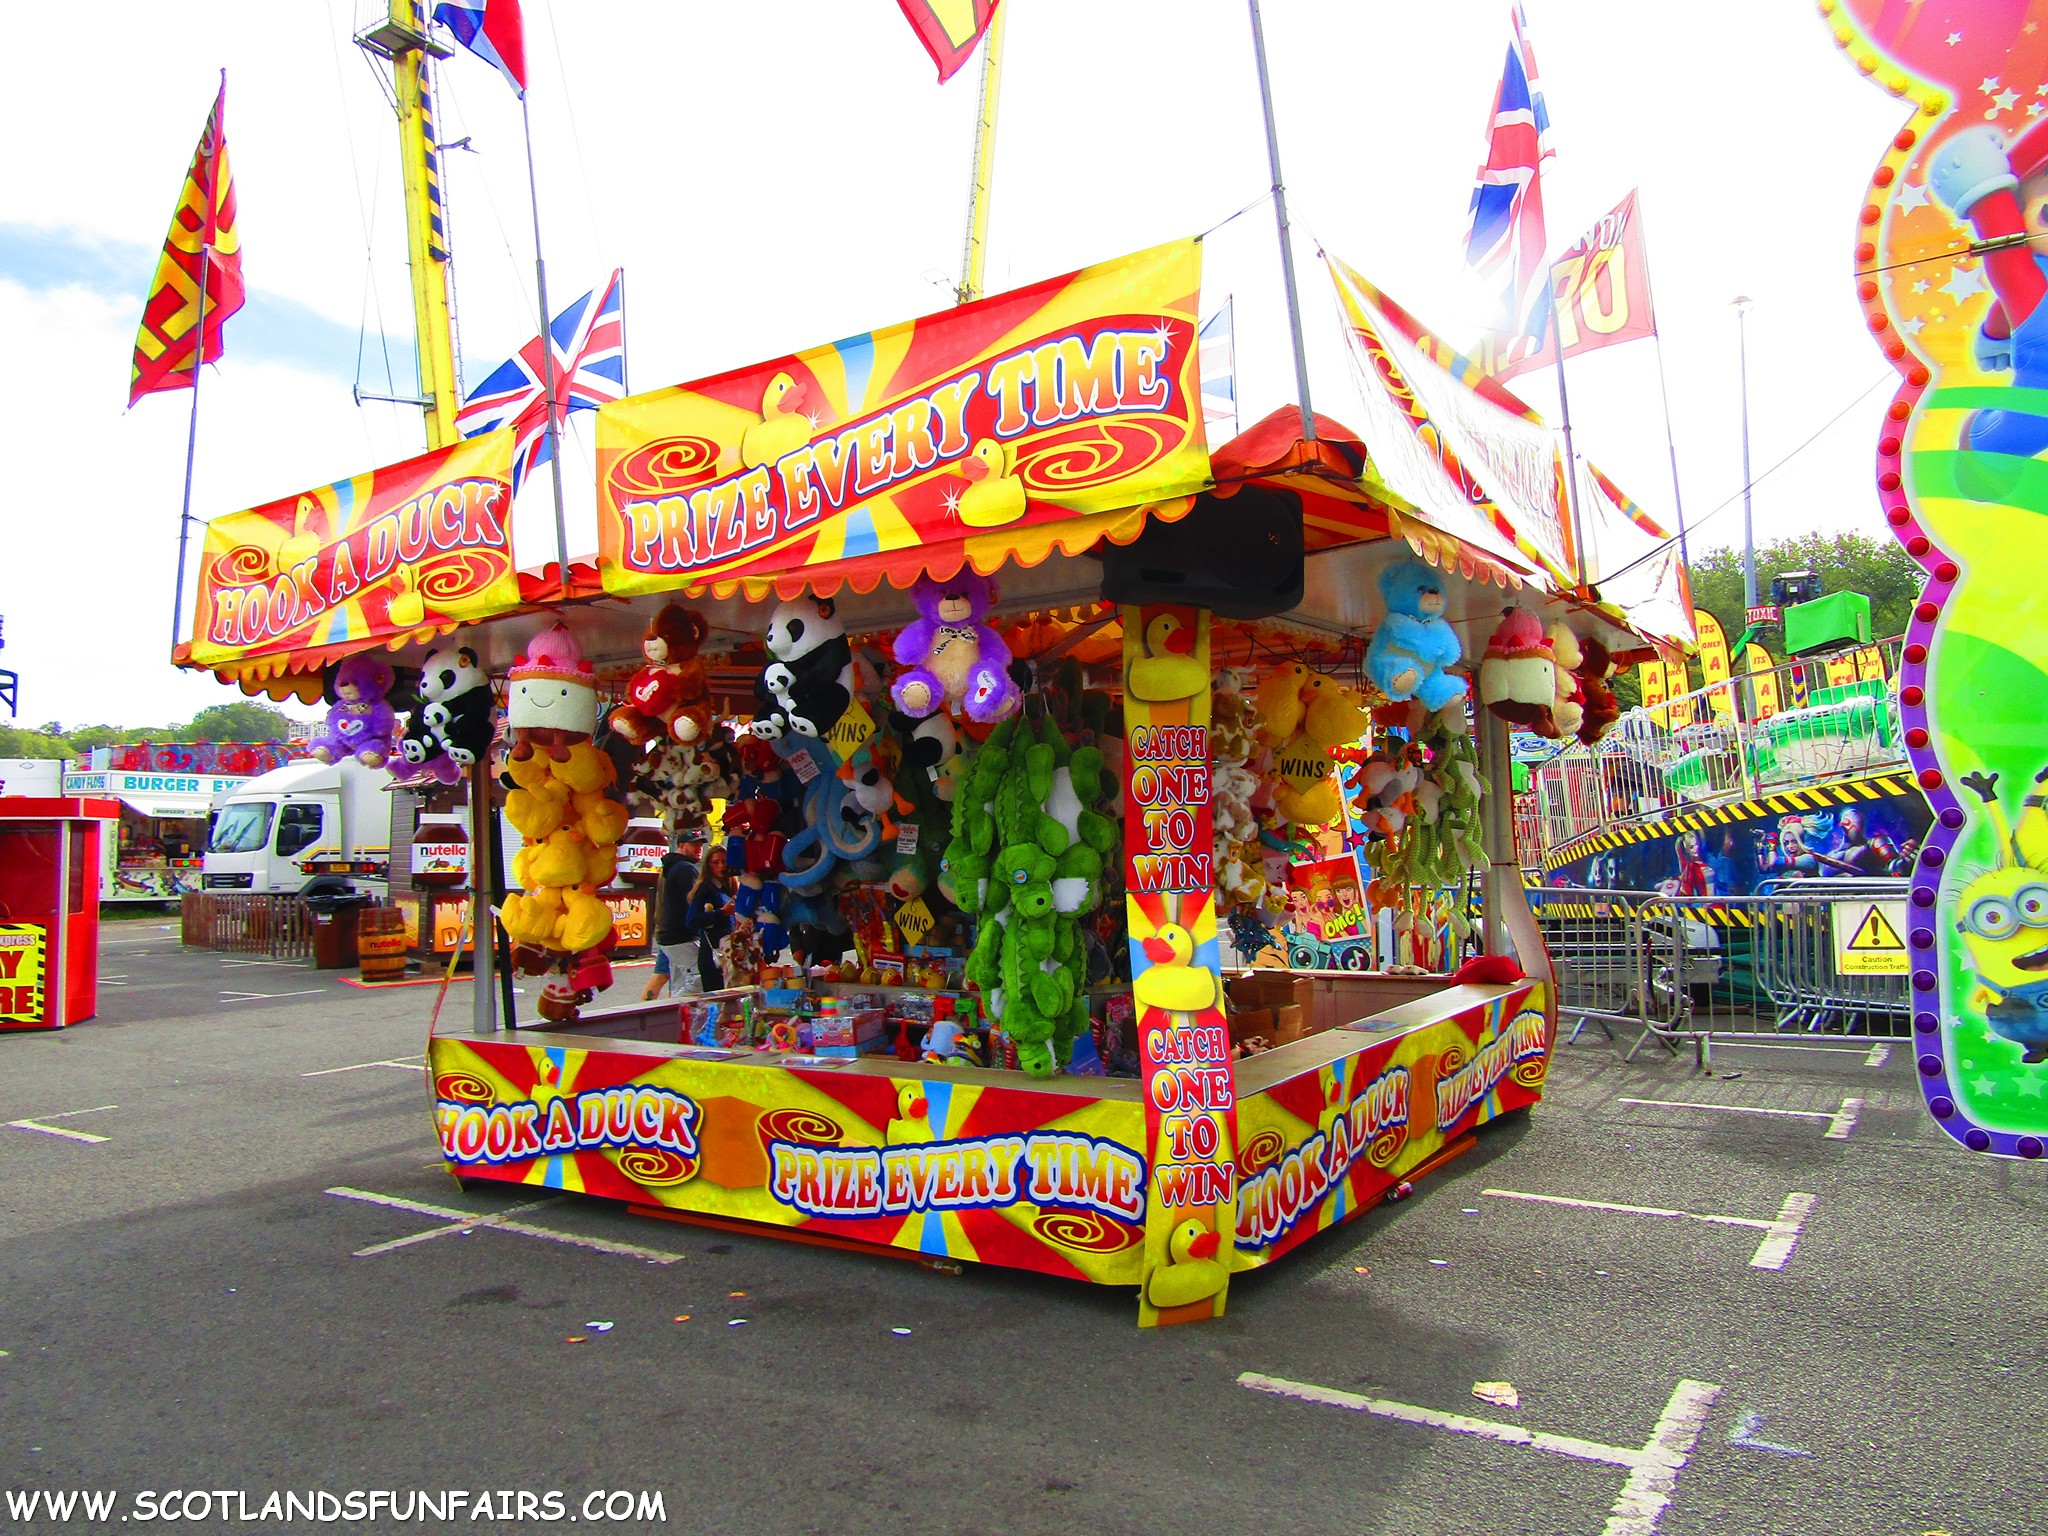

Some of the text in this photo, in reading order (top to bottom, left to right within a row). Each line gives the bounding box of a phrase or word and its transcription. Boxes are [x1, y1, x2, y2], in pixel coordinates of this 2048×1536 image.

[626, 331, 1168, 569] PRIZE EVERY TIME
[212, 480, 505, 645] HOOK A DUCK
[1747, 606, 1778, 623] TOXIC
[1699, 624, 1716, 635] ITS
[1701, 640, 1721, 649] ONLY
[1709, 656, 1721, 671] A
[1753, 656, 1767, 665] ITS
[1648, 671, 1658, 685] A
[1673, 683, 1681, 695] A
[1760, 683, 1771, 697] A
[828, 722, 867, 743] WINS
[1131, 725, 1207, 761] CATCH
[66, 775, 105, 790] CANDY FLOSS
[1281, 758, 1325, 778] WINS
[124, 776, 200, 792] BURGER
[1131, 765, 1209, 806] ONE
[1143, 809, 1195, 850] TO
[420, 844, 467, 856] nutella
[1132, 853, 1210, 894] WIN
[899, 912, 929, 935] WINS
[1324, 903, 1365, 938] OMG!
[1862, 955, 1893, 964] Caution
[1147, 1026, 1226, 1064] CATCH
[1151, 1067, 1233, 1112] ONE
[1437, 1062, 1473, 1128] PRIZE
[1469, 1022, 1514, 1102] EVERY
[437, 1087, 697, 1161] HOOK A DUCK
[1165, 1114, 1220, 1159] TO
[1235, 1068, 1410, 1246] HOOK A DUCK
[772, 1135, 1146, 1224] PRIZE EVERY TIME
[1154, 1162, 1236, 1208] WIN
